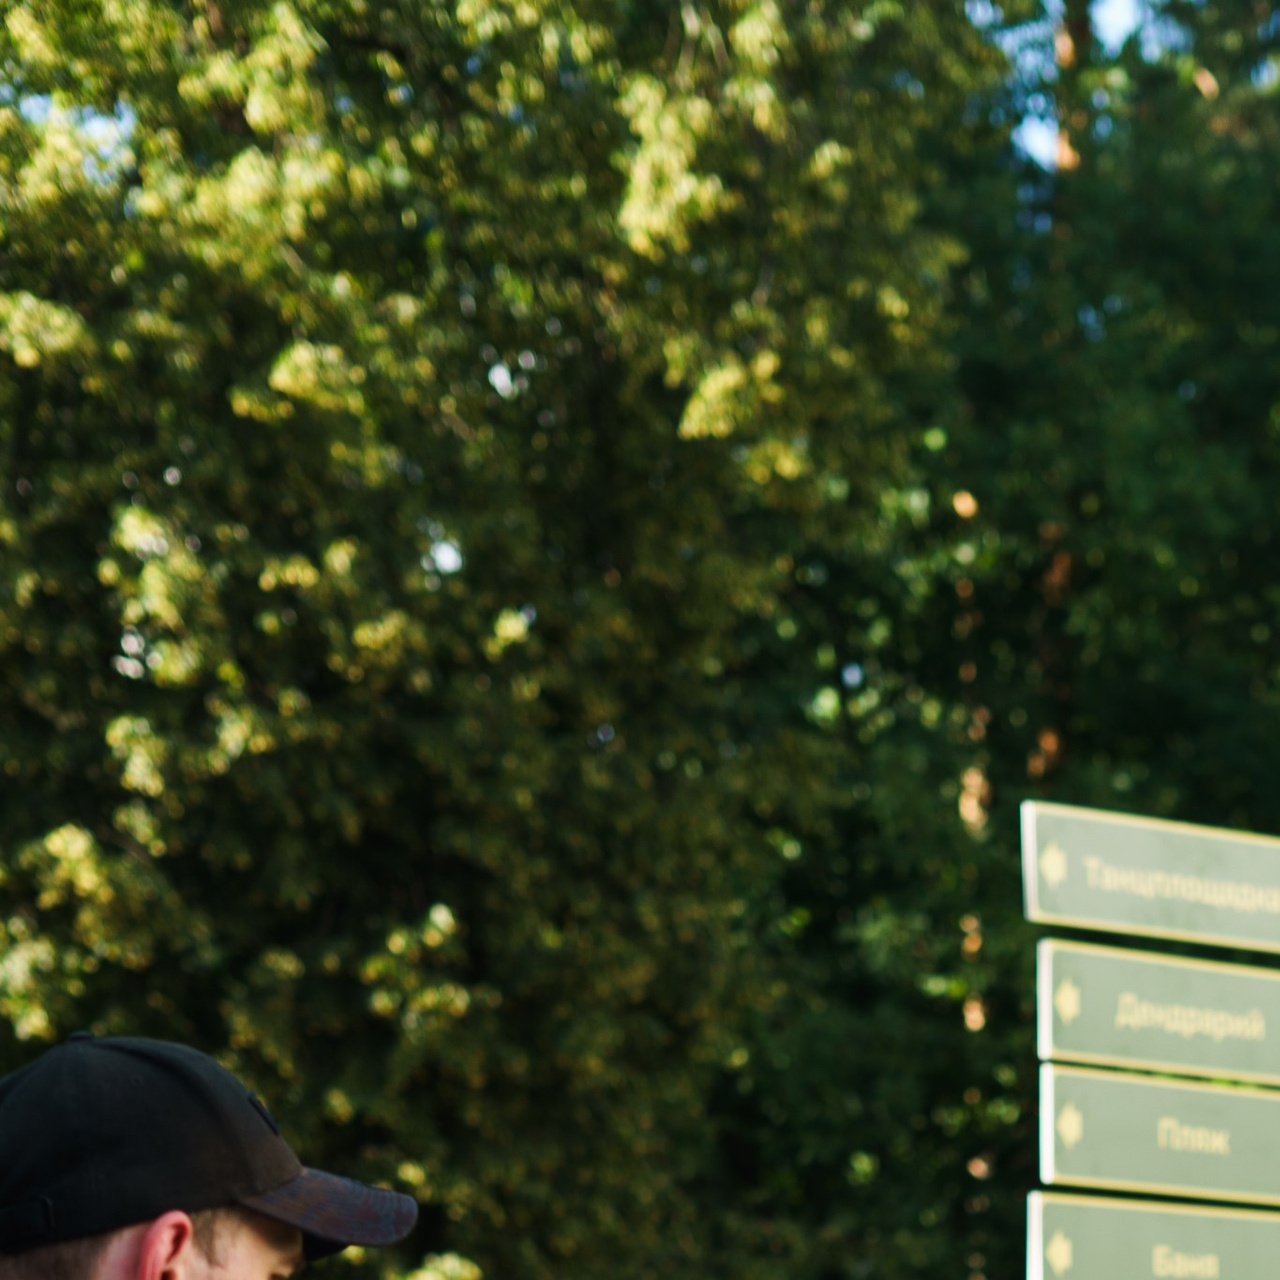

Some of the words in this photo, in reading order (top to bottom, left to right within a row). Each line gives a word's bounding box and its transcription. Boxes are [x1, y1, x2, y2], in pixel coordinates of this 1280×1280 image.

[1115, 992, 1266, 1043] Дендрарий
[1157, 1116, 1230, 1156] Пляж
[1152, 1244, 1220, 1280] Баня
